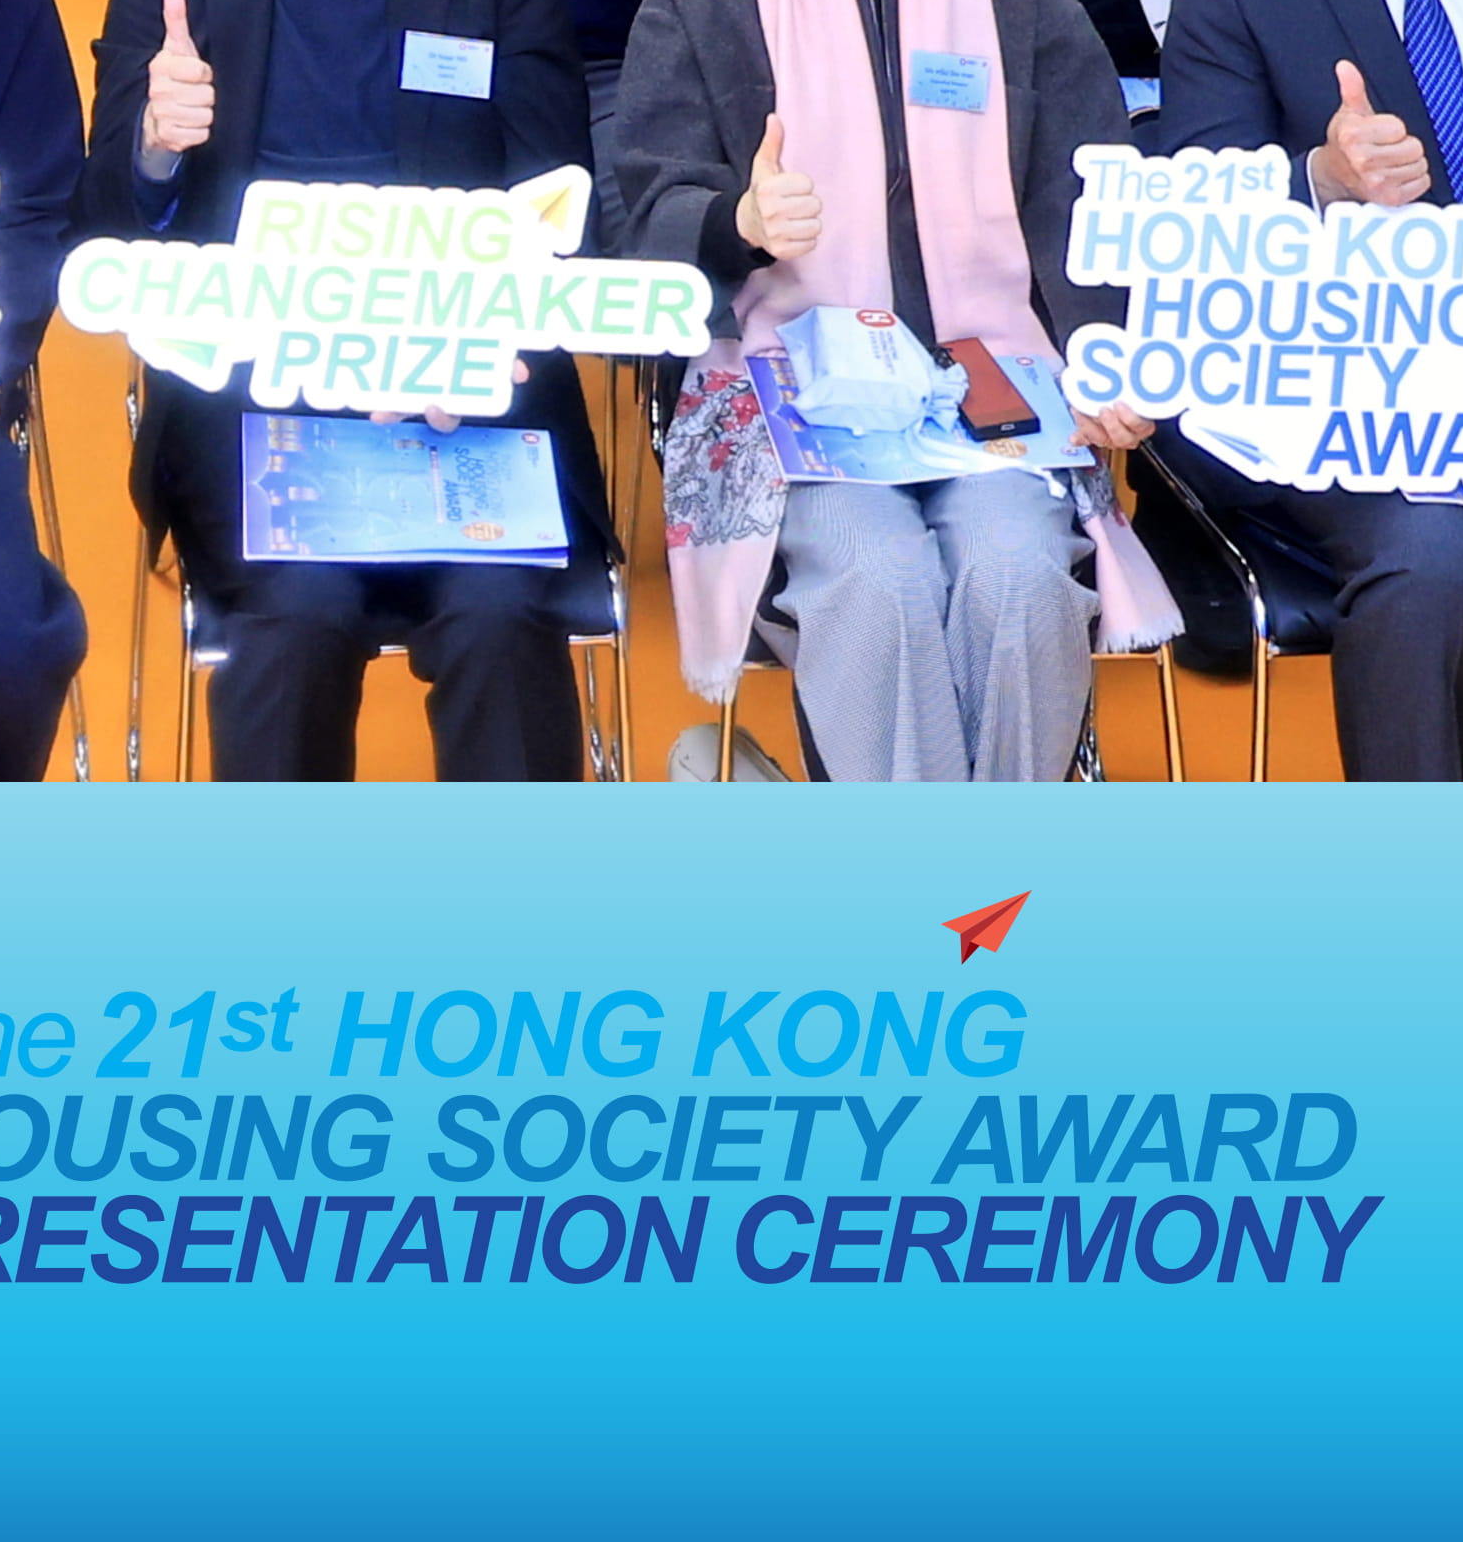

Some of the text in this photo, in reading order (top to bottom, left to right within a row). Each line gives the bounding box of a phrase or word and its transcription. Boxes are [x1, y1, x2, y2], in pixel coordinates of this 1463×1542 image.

[1089, 159, 1277, 205] The 21st
[255, 198, 514, 264] RISING
[1081, 211, 1311, 275] HONG
[77, 255, 696, 339] CHANGEMAKER
[271, 331, 500, 398] PRIZE
[1076, 338, 1420, 409] SOCIETY
